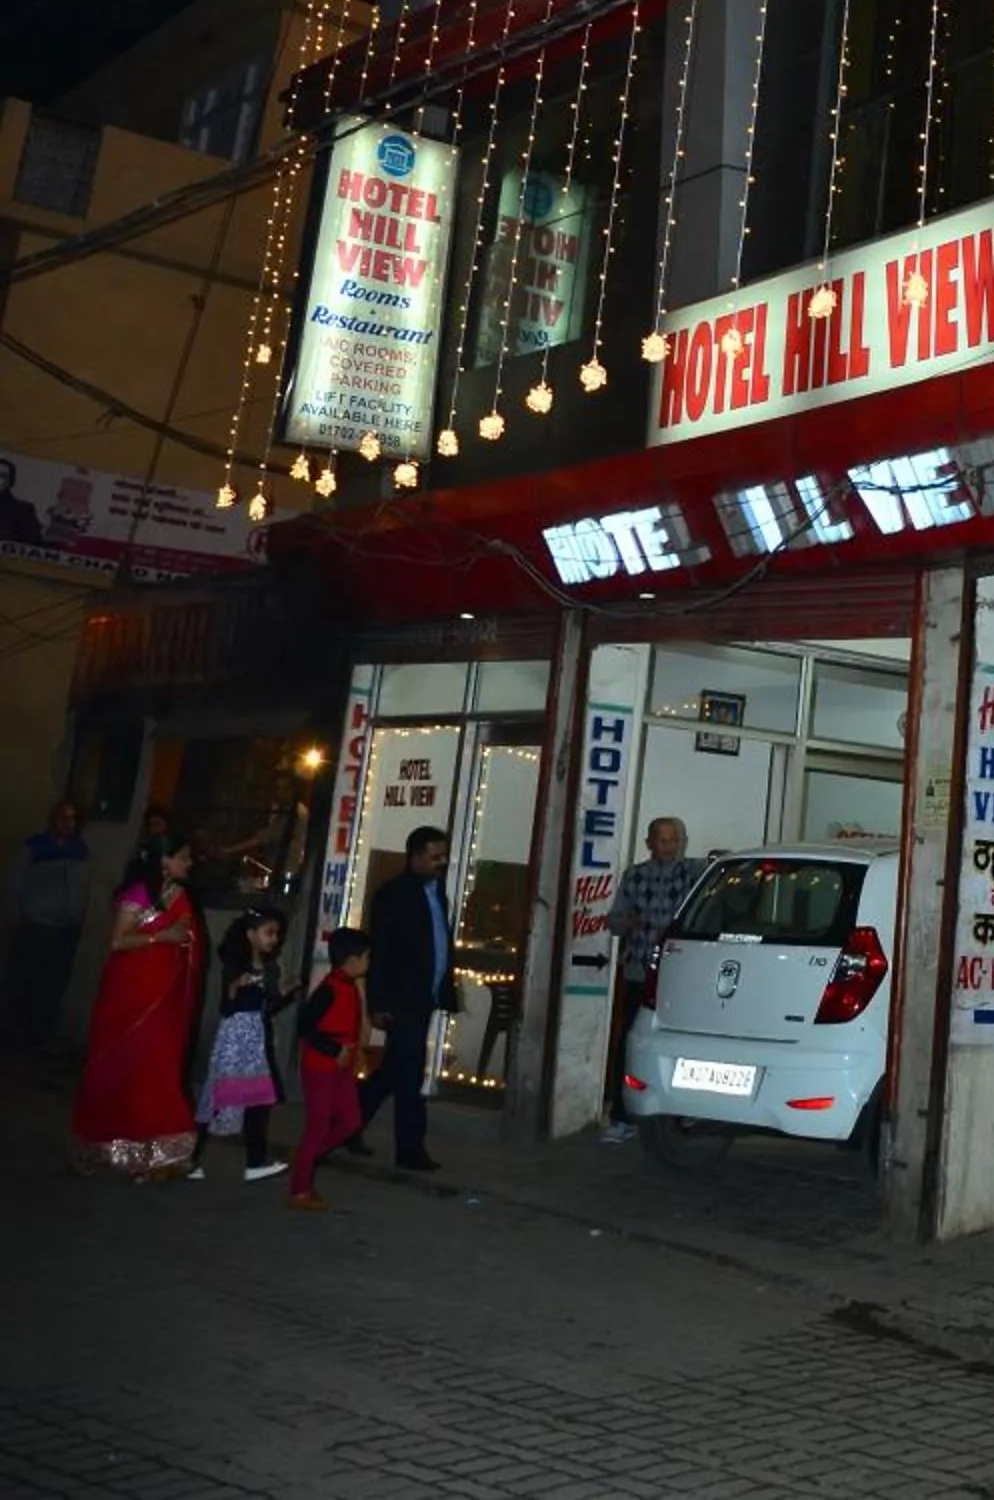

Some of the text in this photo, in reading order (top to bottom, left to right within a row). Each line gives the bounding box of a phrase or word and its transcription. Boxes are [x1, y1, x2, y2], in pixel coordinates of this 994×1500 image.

[337, 169, 441, 223] HOTEL
[348, 208, 421, 255] HILL
[336, 240, 428, 289] VIEW
[339, 278, 412, 310] Rooms
[310, 305, 434, 345] Restaurant
[329, 355, 408, 380] COVERED
[658, 302, 771, 429] HOTEL
[782, 271, 871, 397] HILL
[330, 372, 402, 396] PARKING
[398, 757, 432, 781] HOTEL
[384, 785, 438, 807] HILL VIEW
[581, 716, 625, 870] HOTEL
[575, 874, 614, 902] Hill
